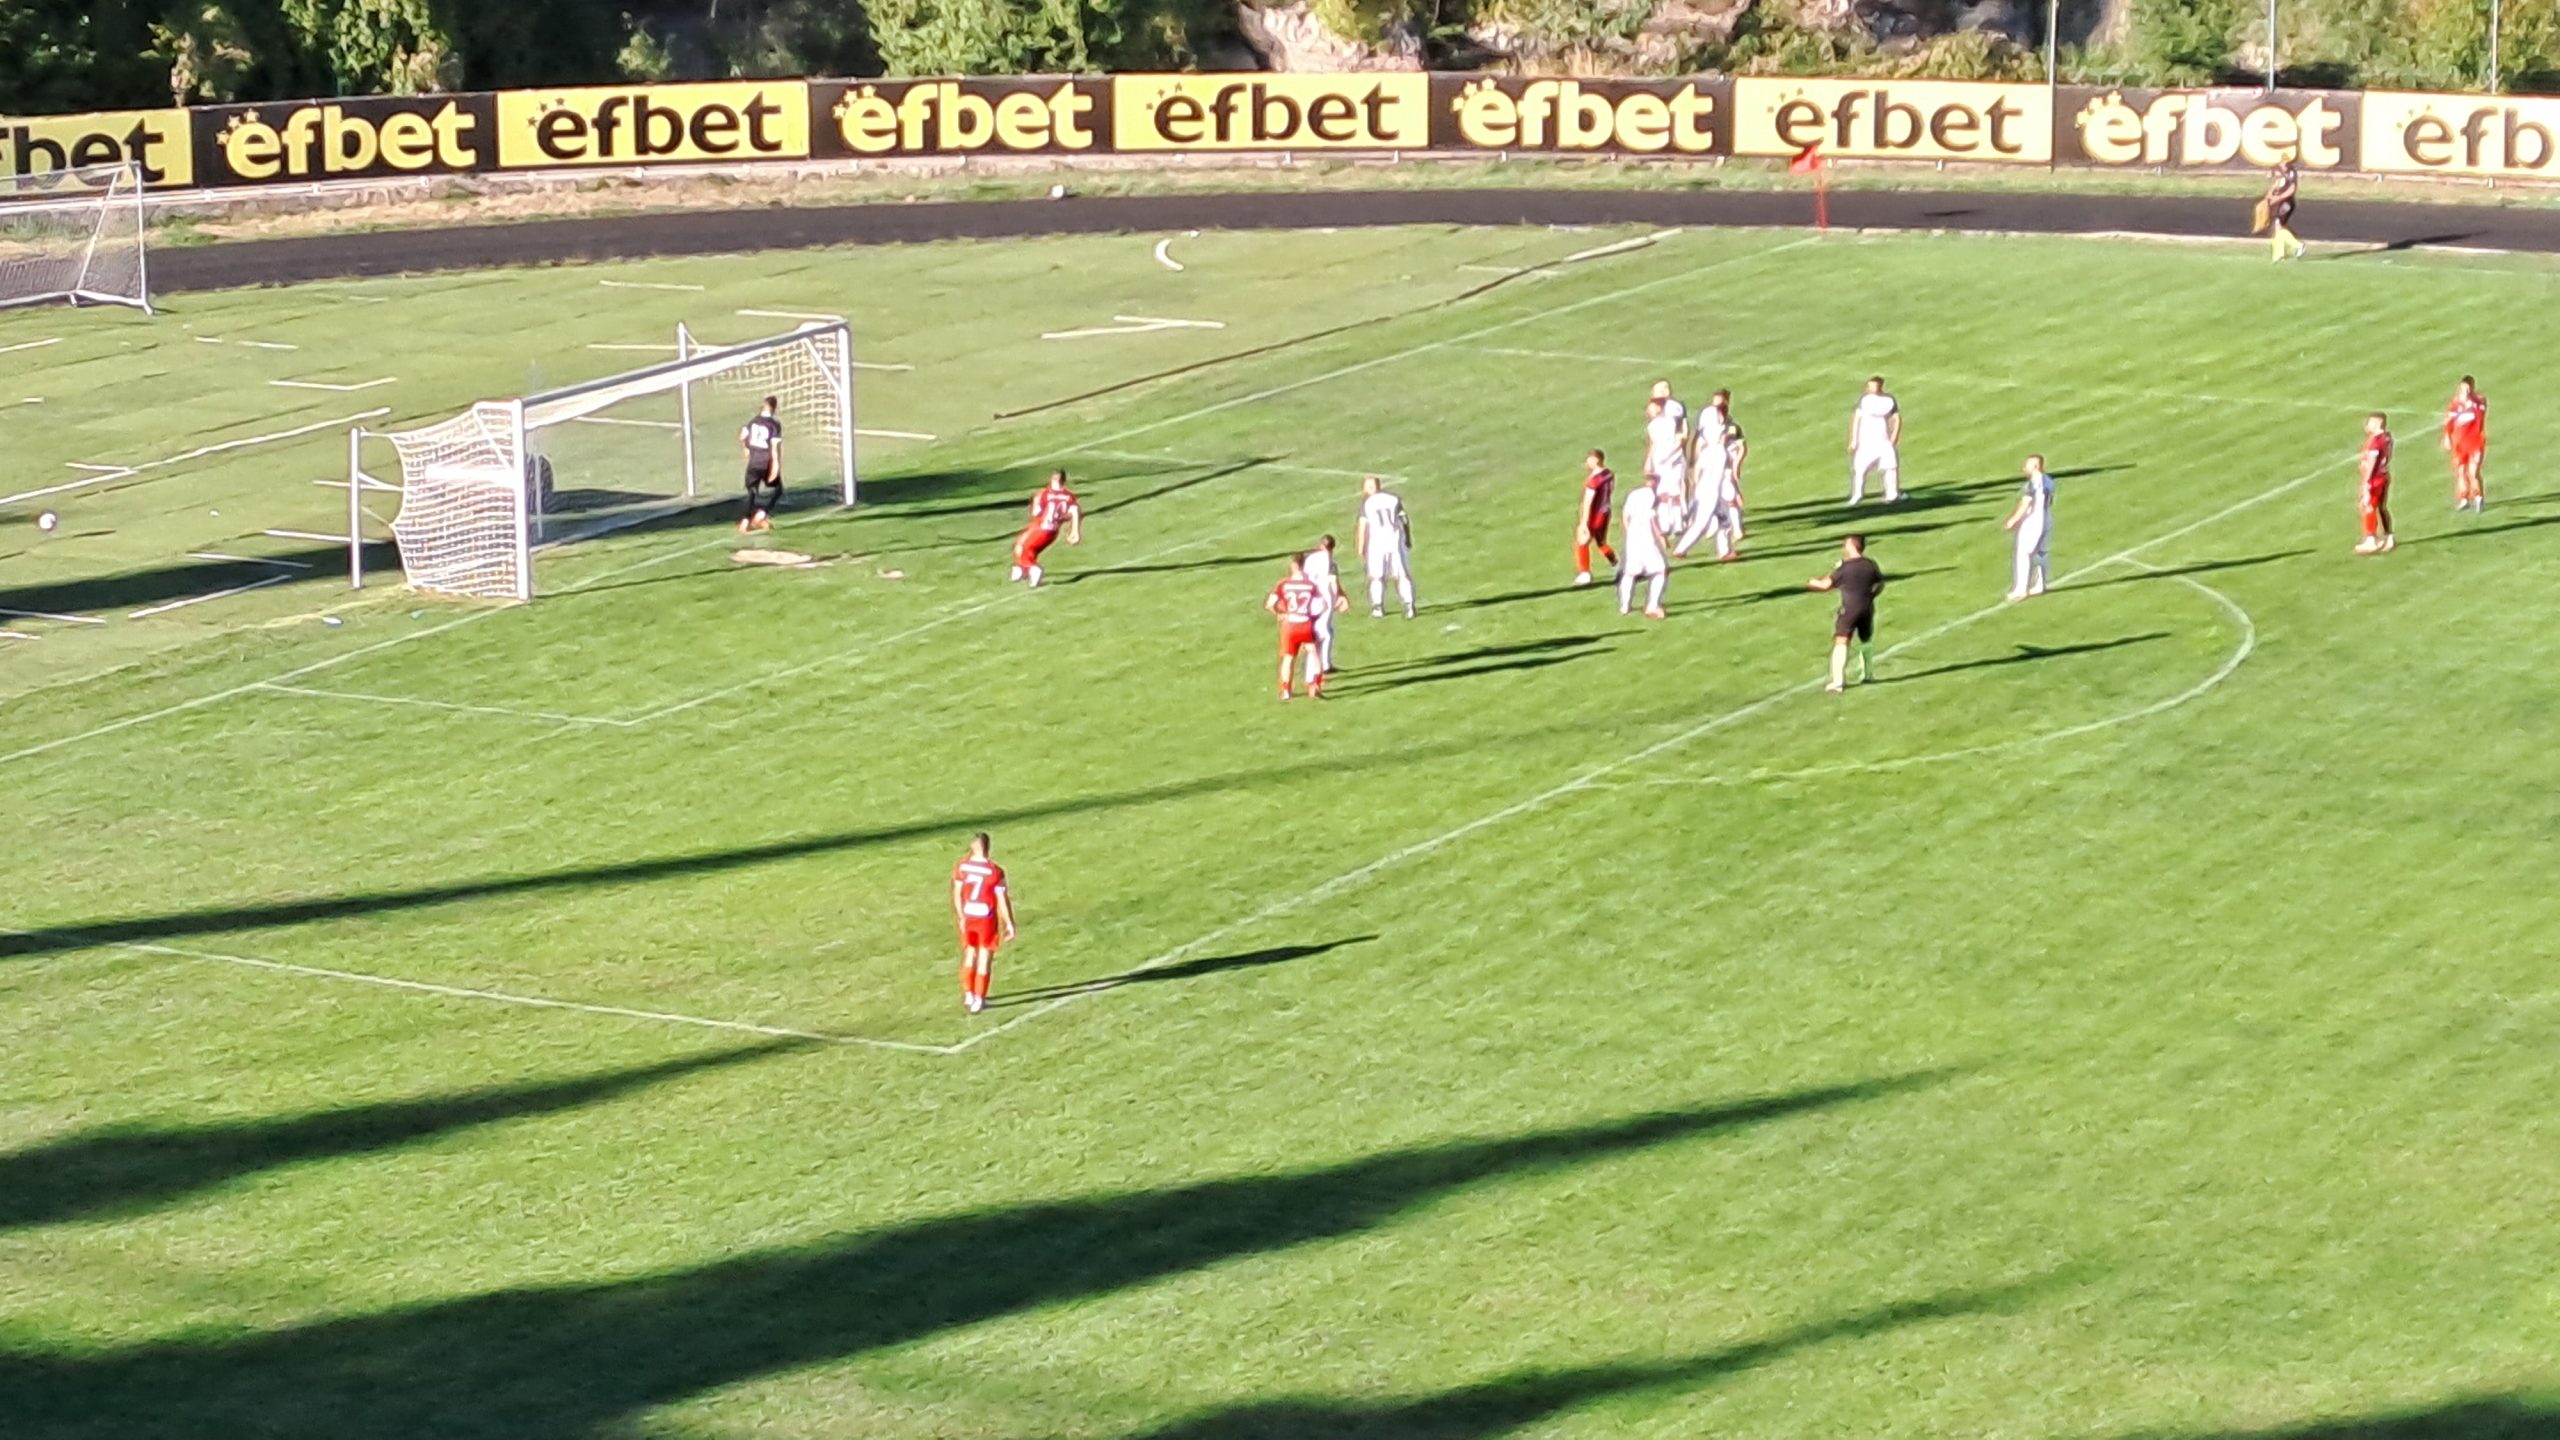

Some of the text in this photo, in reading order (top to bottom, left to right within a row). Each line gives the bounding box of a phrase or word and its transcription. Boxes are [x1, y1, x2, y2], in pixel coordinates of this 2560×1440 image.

[227, 101, 476, 178] efbet
[537, 90, 782, 160] efbet
[842, 82, 1093, 152] efbet
[1153, 82, 1400, 143] efbet
[1461, 80, 1713, 151] efbet
[1775, 89, 2024, 154] efbet
[2082, 95, 2341, 168] efbet
[0, 117, 165, 190] bet
[965, 873, 984, 901] 7
